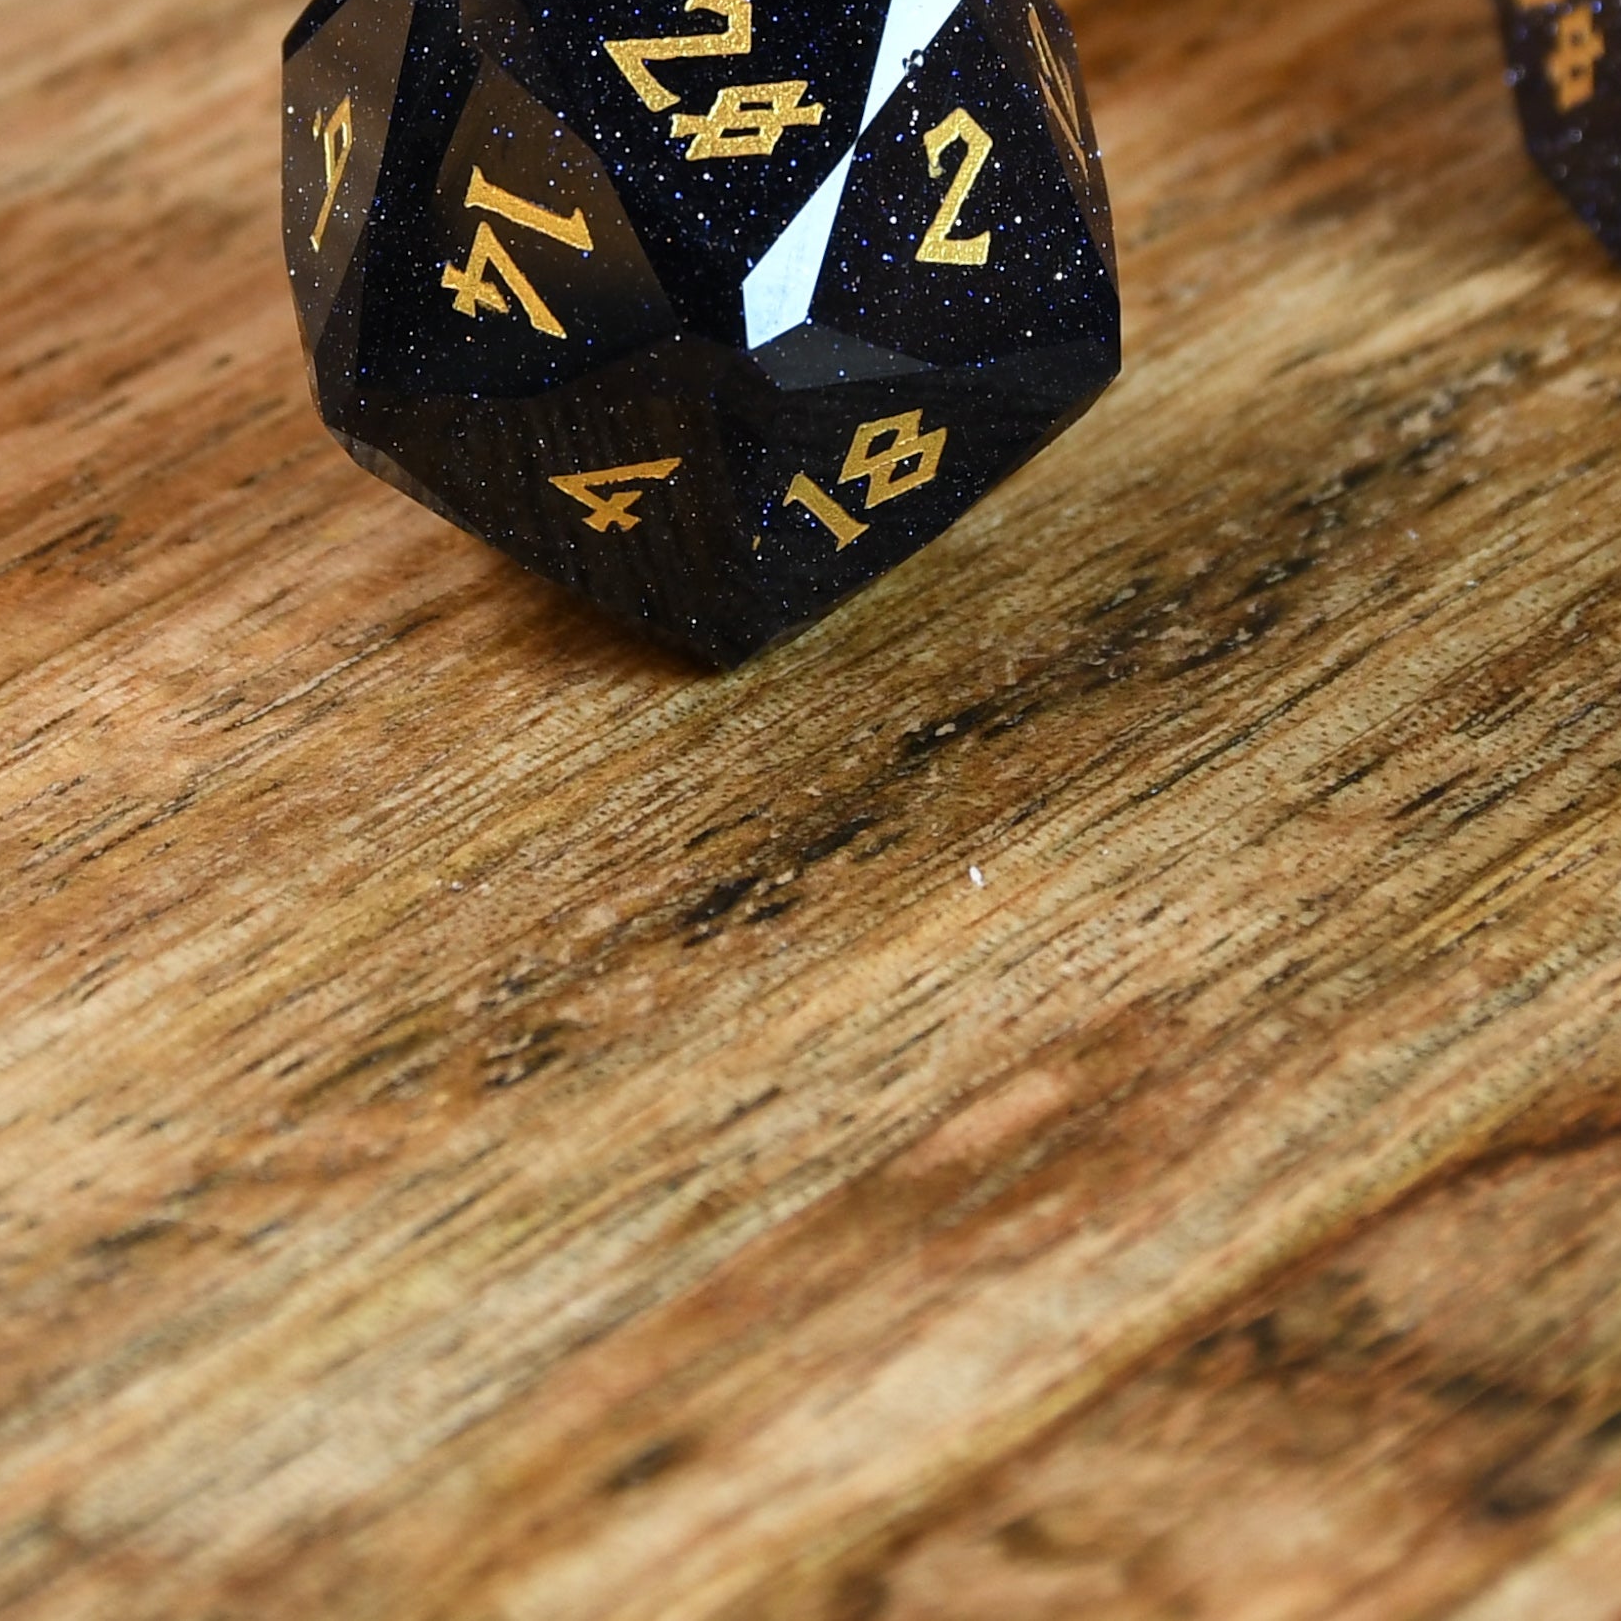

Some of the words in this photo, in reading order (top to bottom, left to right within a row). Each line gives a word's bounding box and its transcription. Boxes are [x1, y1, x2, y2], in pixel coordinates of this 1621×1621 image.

[442, 167, 594, 336] 14
[917, 109, 991, 263] 2
[551, 458, 681, 532] 4
[784, 409, 948, 550] 18
